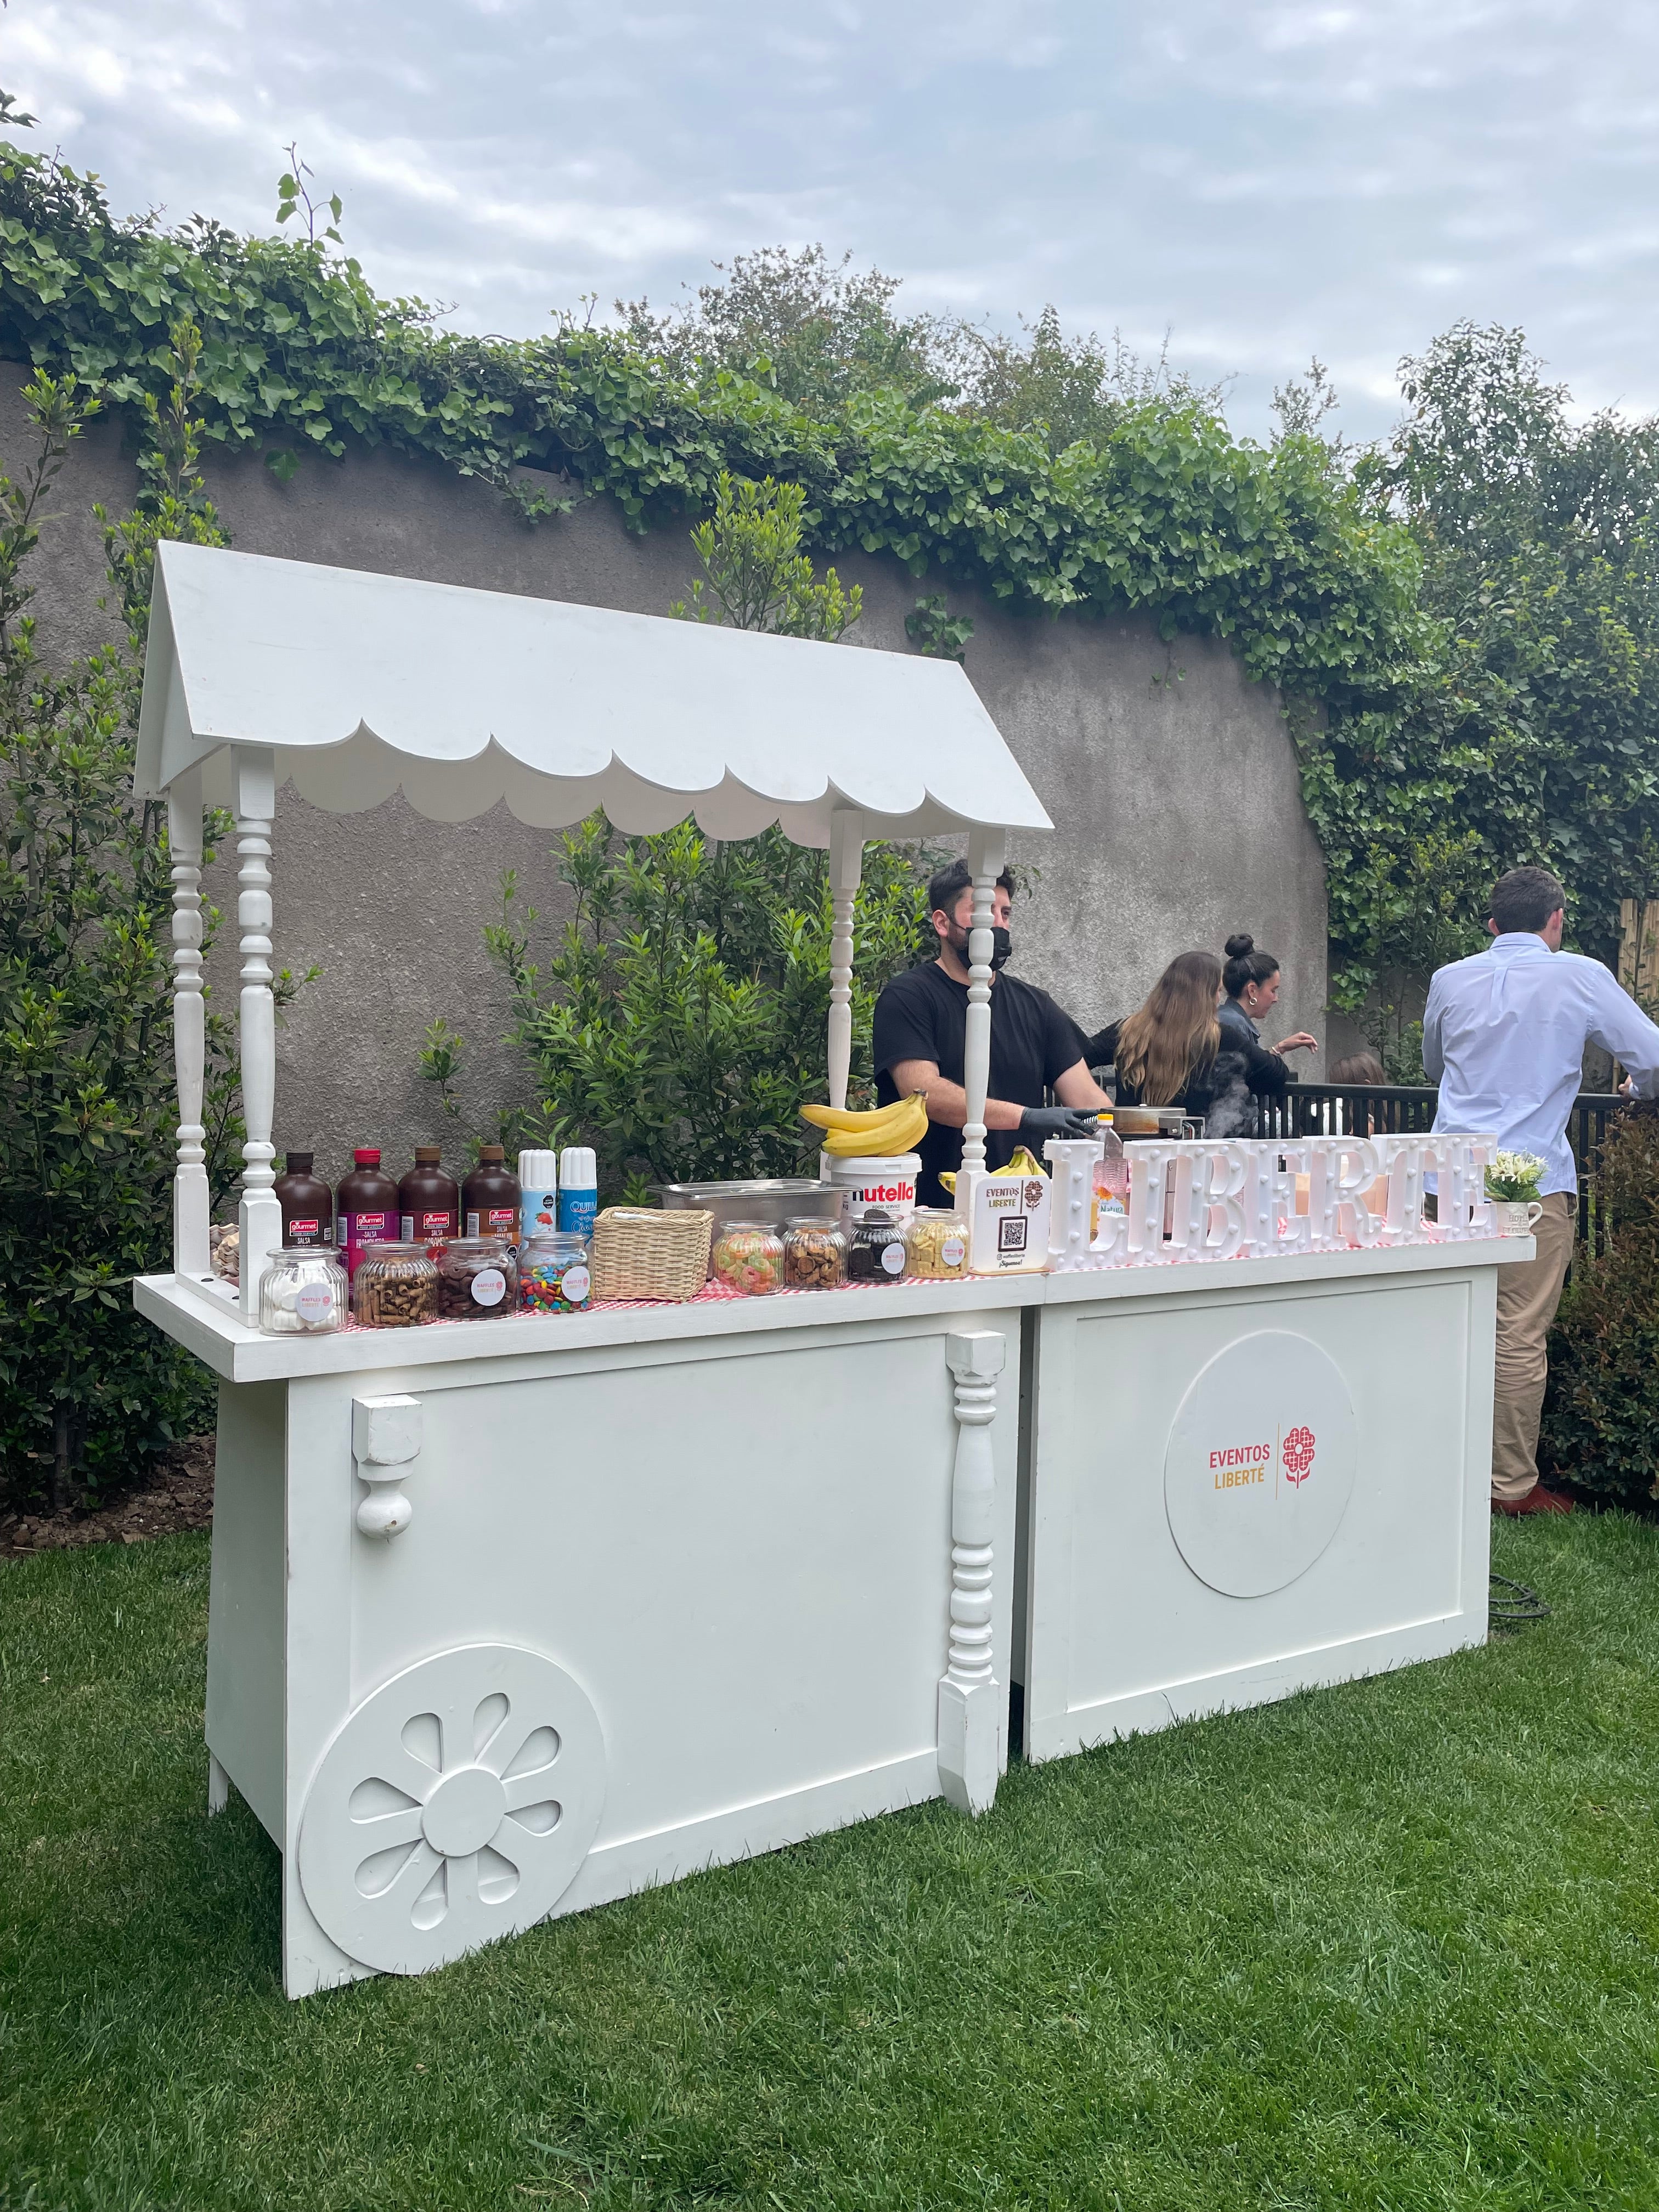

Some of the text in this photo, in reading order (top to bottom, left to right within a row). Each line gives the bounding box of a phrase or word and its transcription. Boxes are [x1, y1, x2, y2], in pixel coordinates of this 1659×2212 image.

[853, 1182, 913, 1202] nutella
[986, 1188, 1019, 1197] EVENTOS
[1044, 1133, 1497, 1272] LIBERTE
[425, 1216, 448, 1224] gourmet
[491, 1212, 512, 1220] gourmet
[358, 1217, 382, 1225] gourmet
[291, 1223, 317, 1231] gourmet
[1209, 1443, 1270, 1469] EVENTOS
[1215, 1463, 1265, 1489] LIBERTÉ
